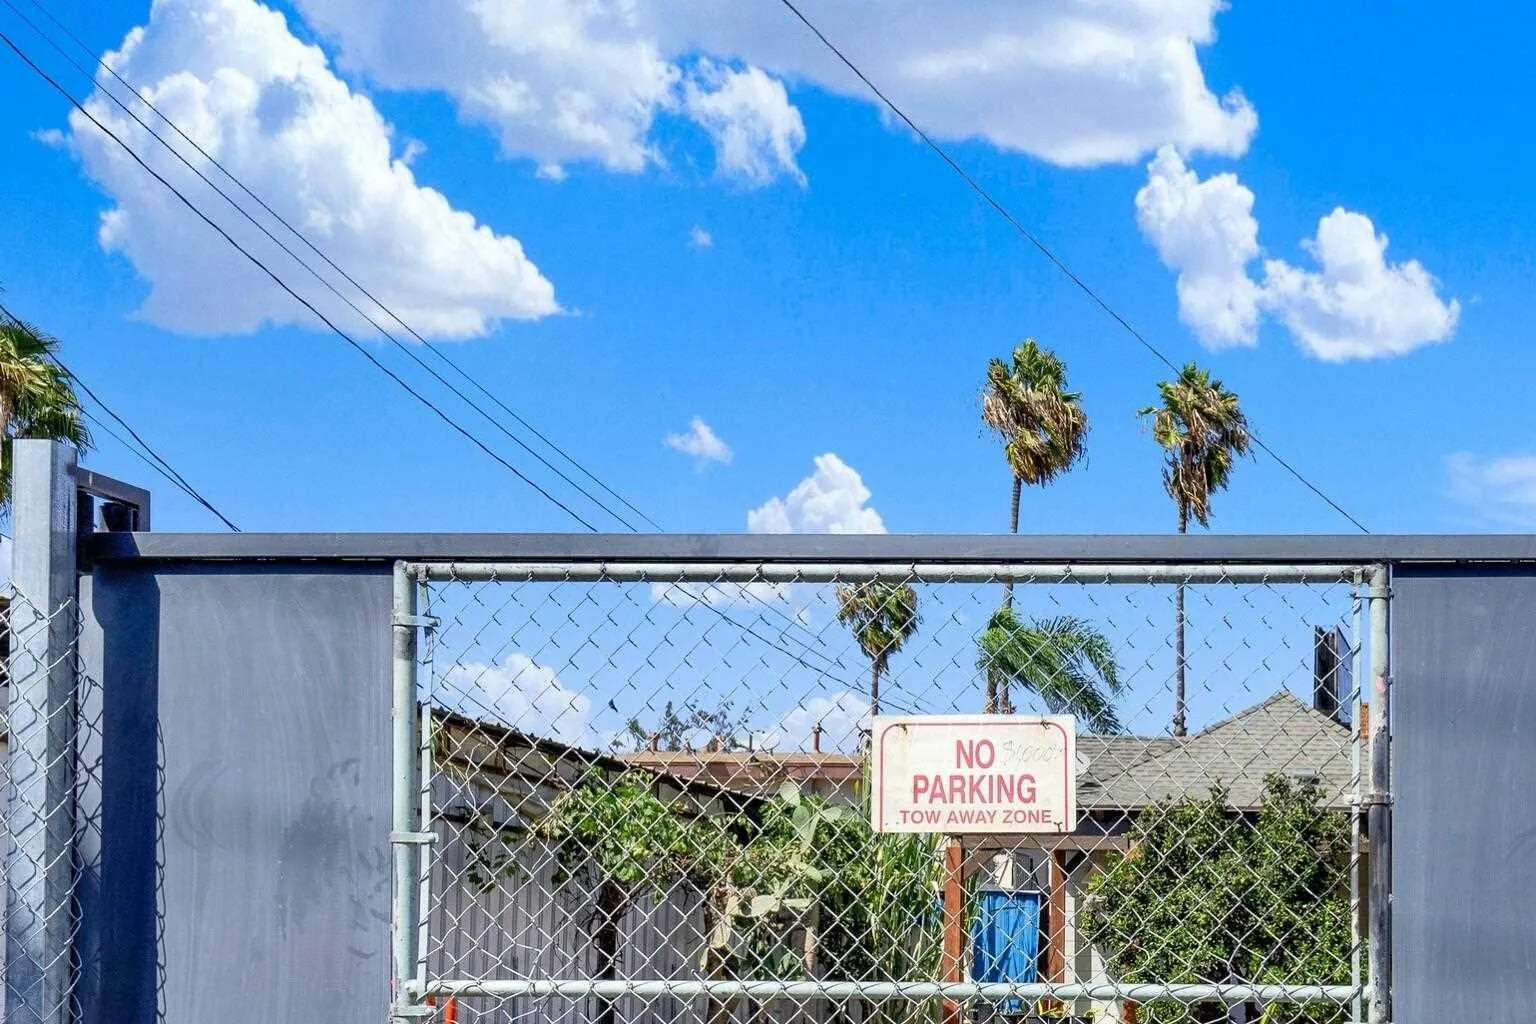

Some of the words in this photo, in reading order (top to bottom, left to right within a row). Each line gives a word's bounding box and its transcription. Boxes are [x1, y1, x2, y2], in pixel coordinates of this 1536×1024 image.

[956, 739, 995, 769] NO
[912, 774, 1036, 804] PARKING
[900, 809, 941, 824] TOW
[946, 809, 998, 824] AWAY
[1002, 809, 1052, 824] ZONE
